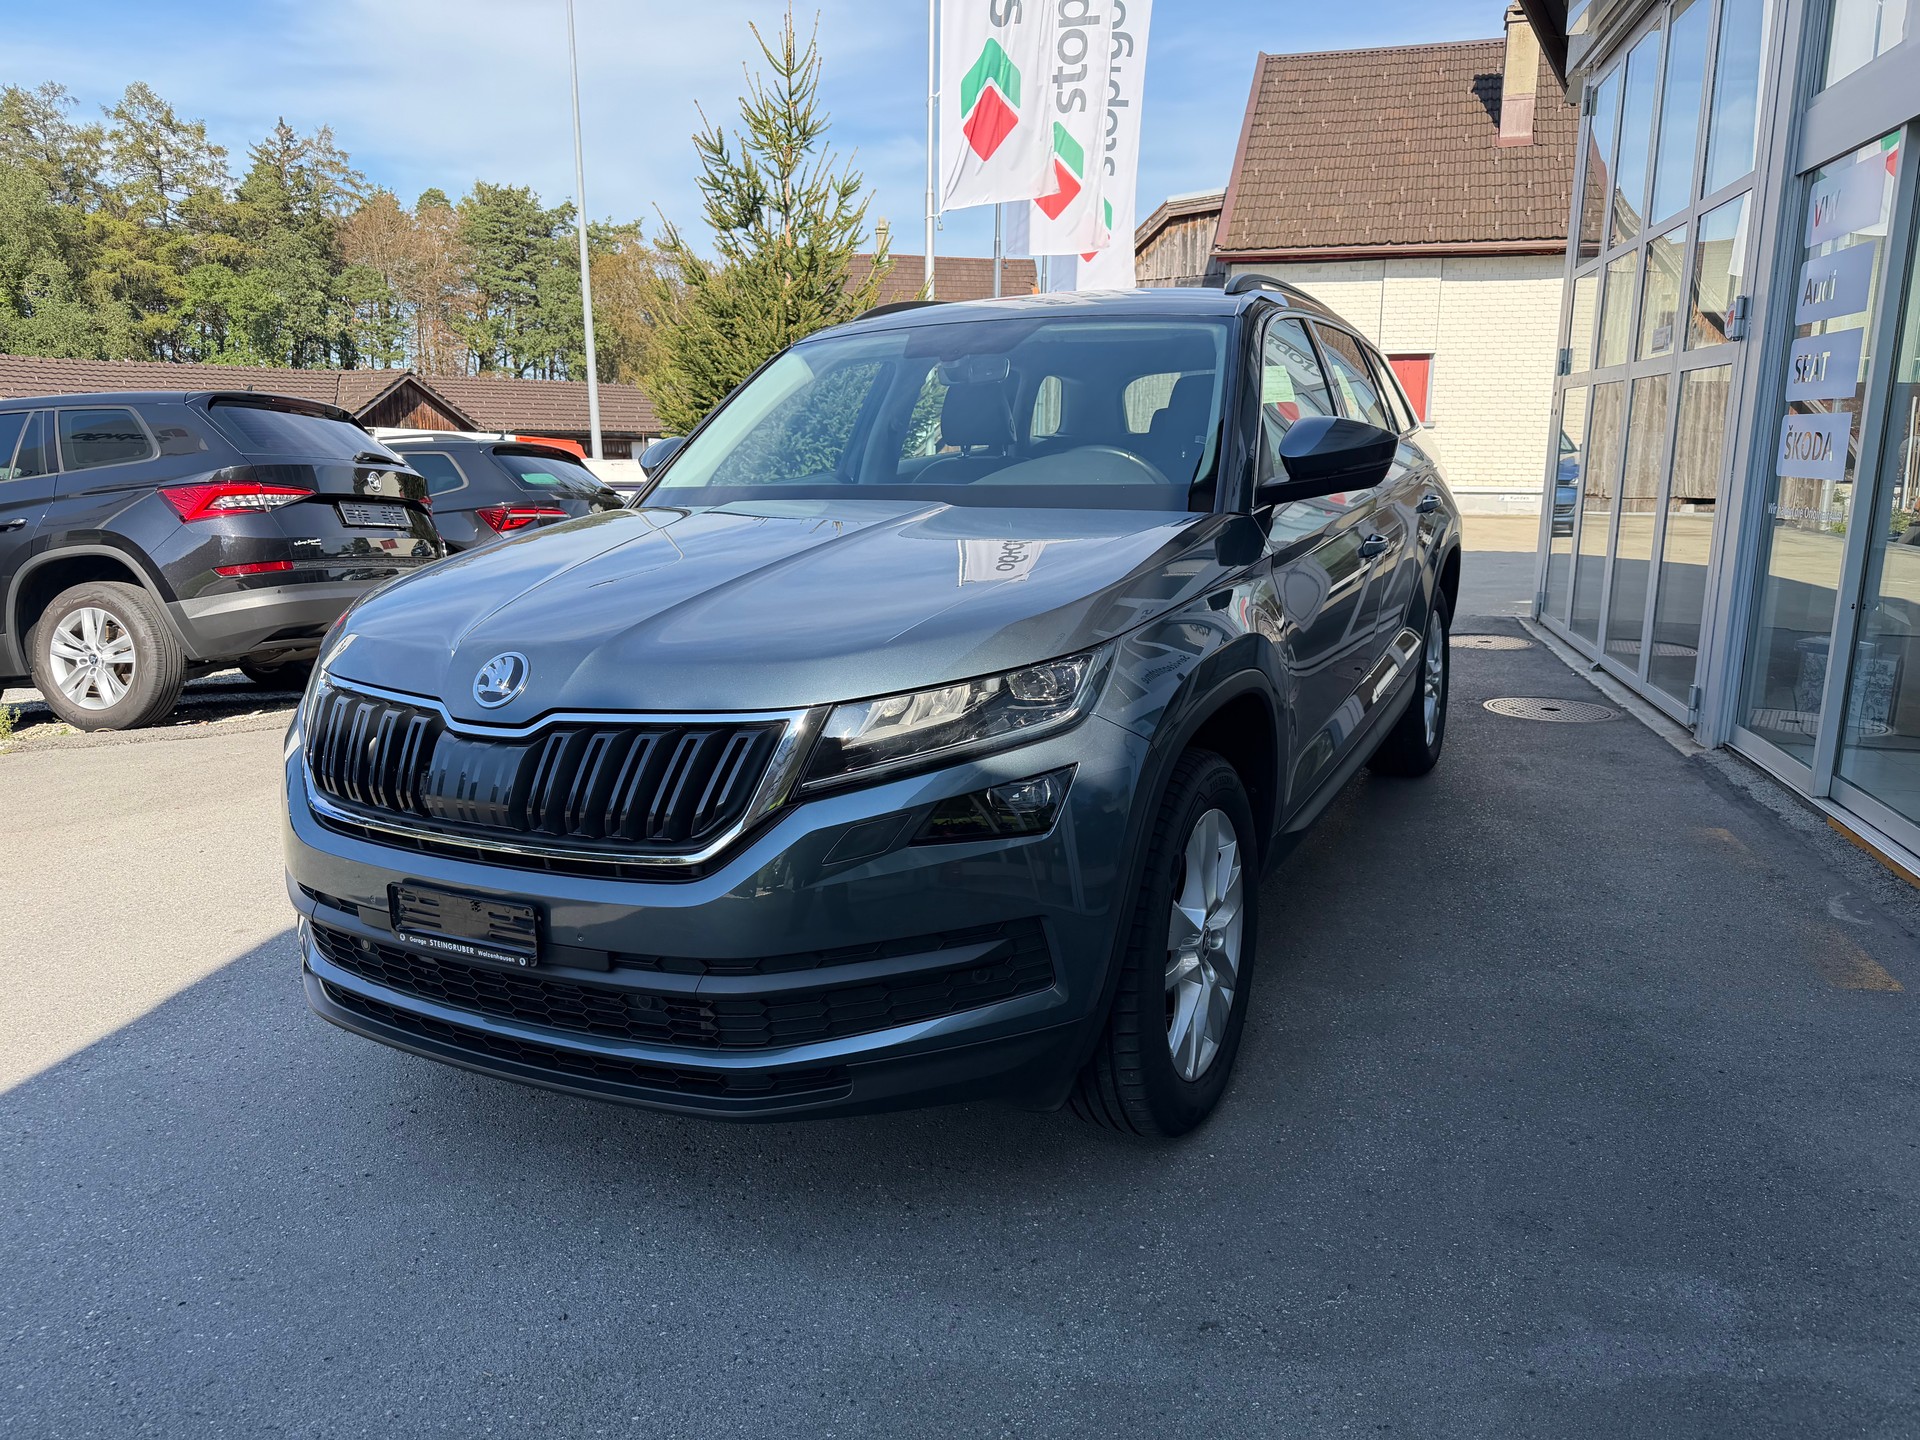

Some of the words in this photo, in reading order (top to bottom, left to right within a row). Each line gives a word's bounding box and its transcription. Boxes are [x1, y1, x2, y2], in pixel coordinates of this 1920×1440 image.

[1815, 189, 1841, 227] VW
[1802, 269, 1837, 306] Audi
[1794, 351, 1831, 384] SEAT
[1784, 424, 1833, 462] ŠKODA
[409, 936, 427, 945] Garage
[429, 939, 475, 955] STEINGRUBER
[478, 950, 516, 963] Walzenhausen
